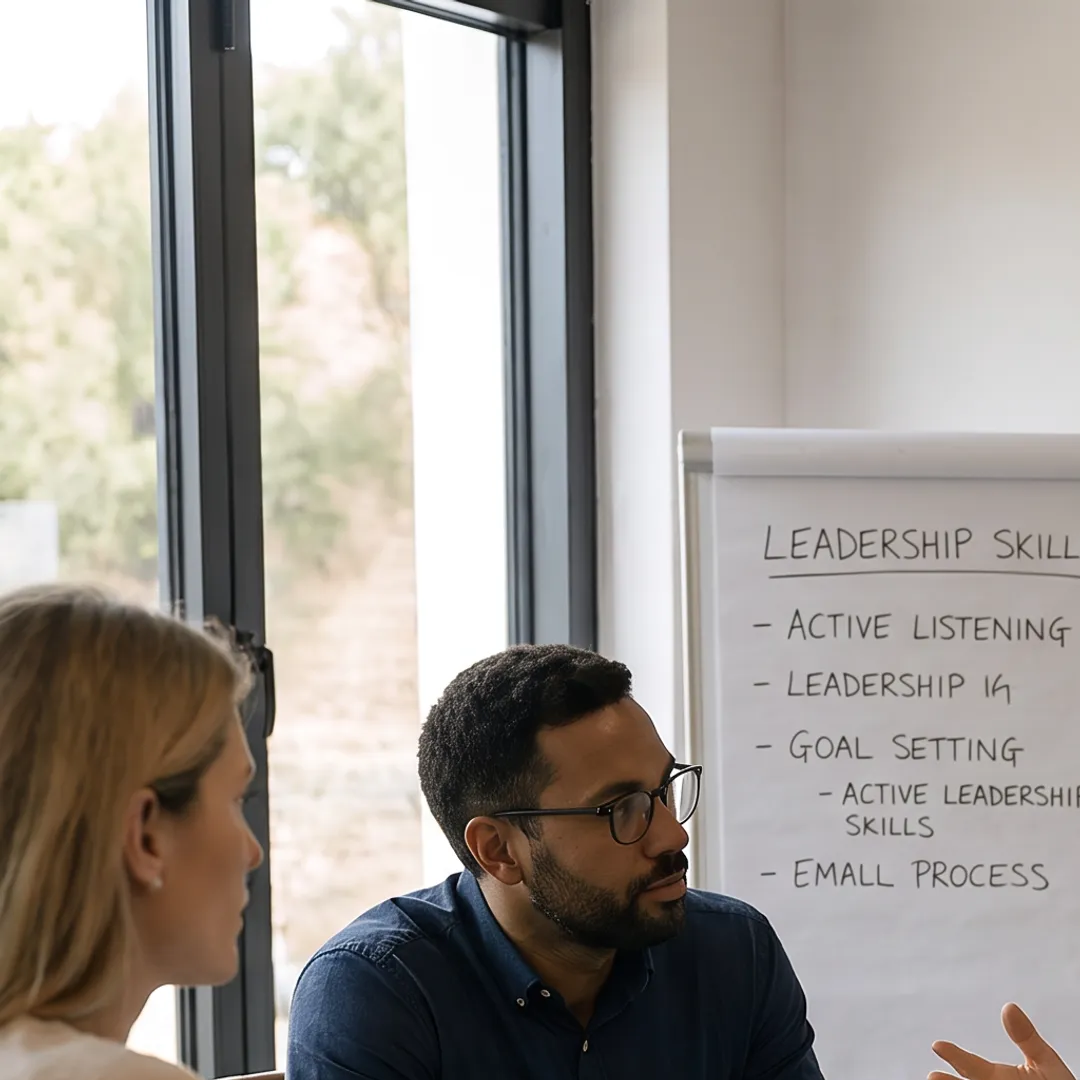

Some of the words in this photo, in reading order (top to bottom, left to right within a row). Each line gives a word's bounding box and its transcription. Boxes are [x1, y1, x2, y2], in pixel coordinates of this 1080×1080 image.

[763, 524, 973, 562] LEADERSHIP
[787, 608, 893, 641] ACTIVE
[912, 613, 1073, 649] LISTENING
[787, 670, 966, 700] LEADERSHIP
[789, 729, 874, 764] GOAL
[891, 733, 1025, 769] SETTING
[841, 781, 929, 807] ACTIVE
[845, 813, 936, 839] SKILLS
[910, 858, 1051, 892] PROCESS
